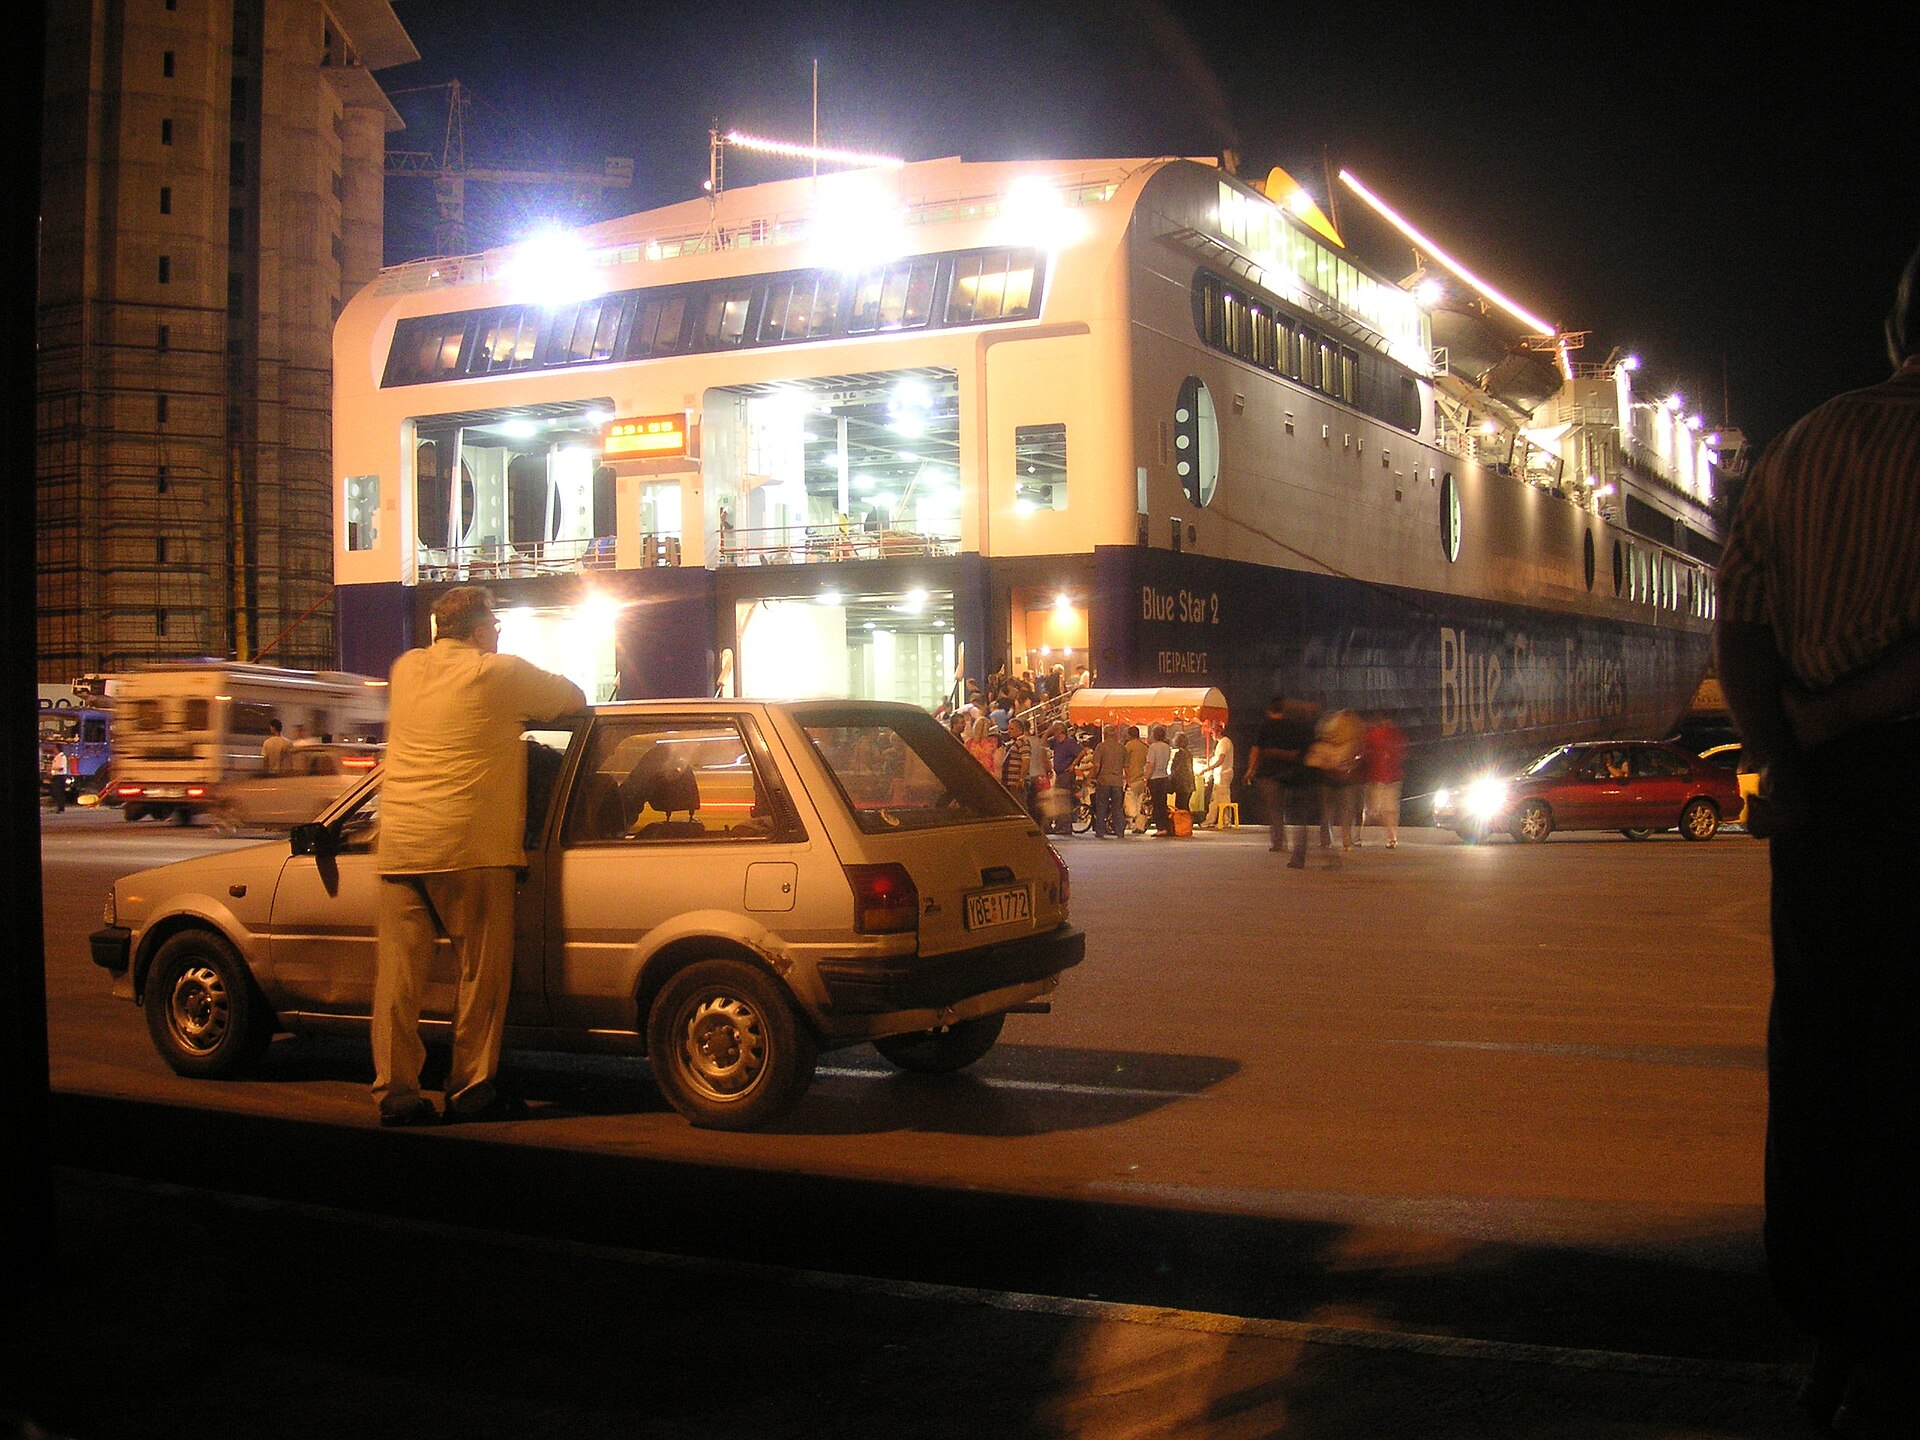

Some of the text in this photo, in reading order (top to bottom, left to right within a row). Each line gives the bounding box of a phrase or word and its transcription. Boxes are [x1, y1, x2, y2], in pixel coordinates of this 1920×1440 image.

[1142, 586, 1220, 624] Blue Star 2
[1440, 627, 1501, 737] Blue
